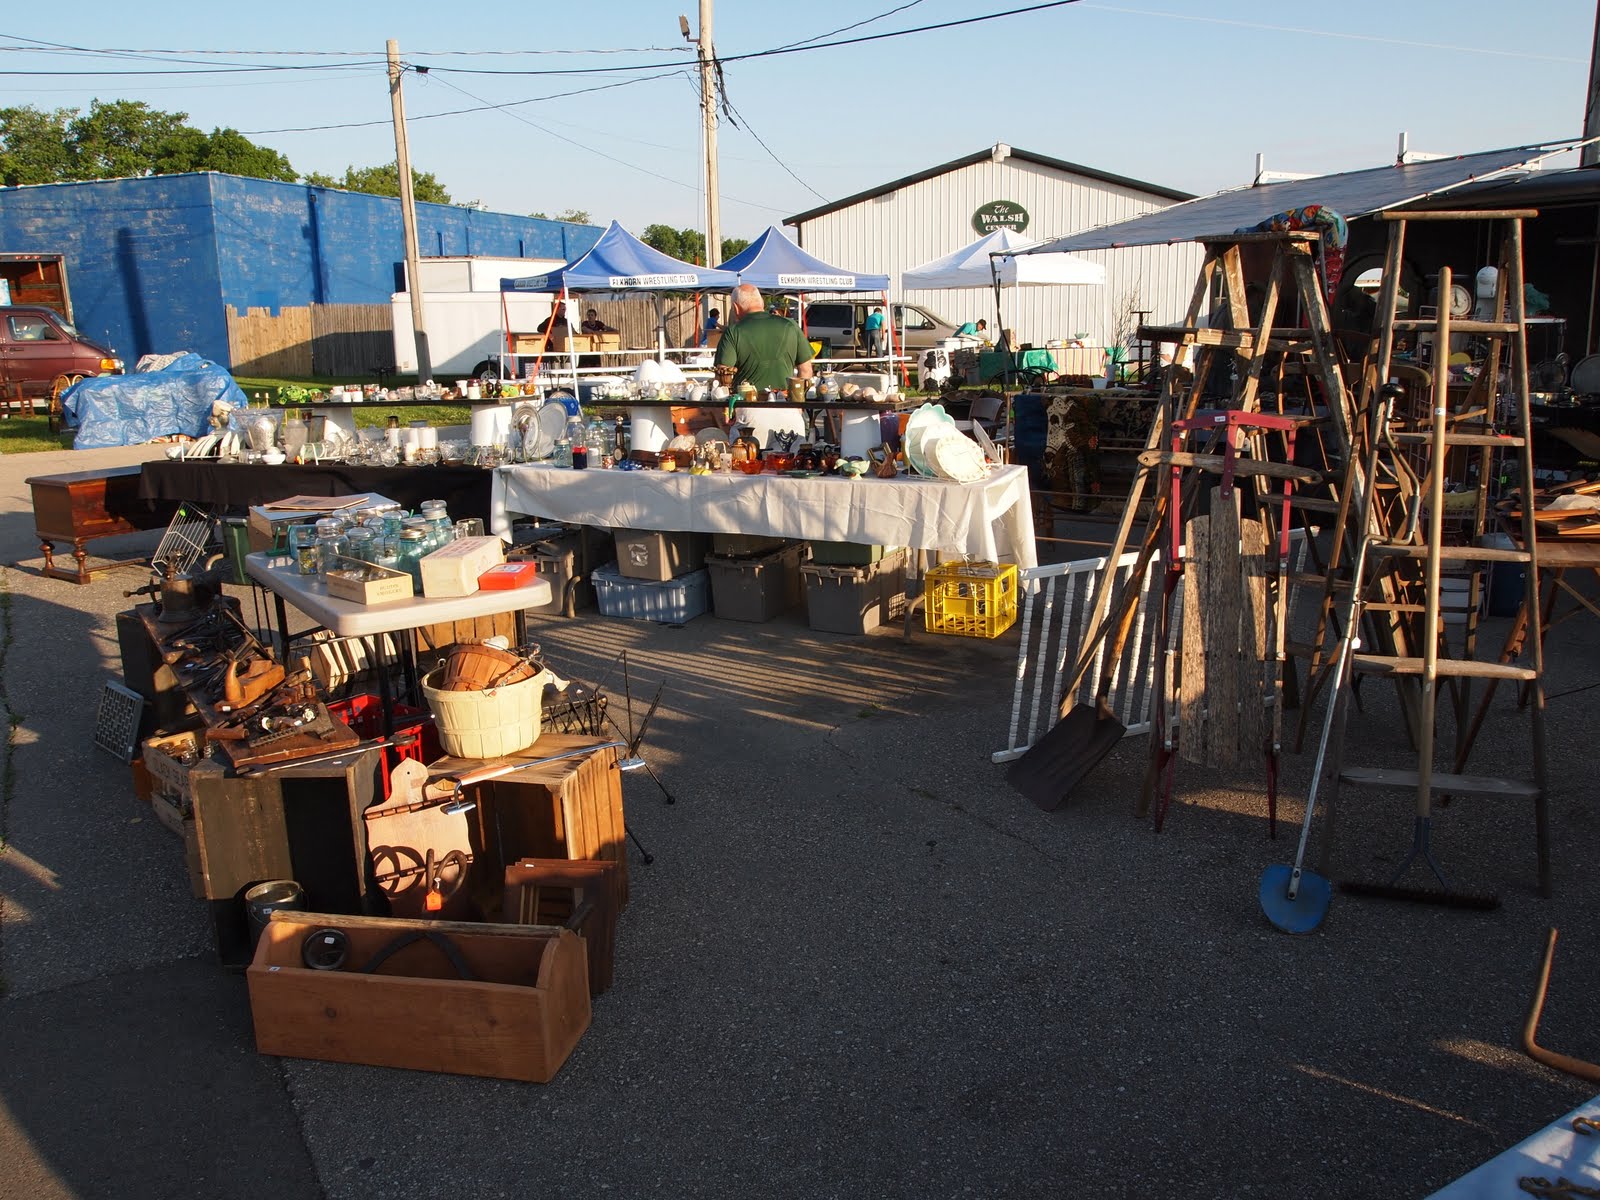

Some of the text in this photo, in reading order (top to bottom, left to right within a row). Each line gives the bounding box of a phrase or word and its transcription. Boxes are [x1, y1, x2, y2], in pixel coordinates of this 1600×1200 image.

[994, 204, 1009, 214] The
[980, 212, 1024, 224] WALSH
[643, 275, 679, 285] WRESTLING
[680, 274, 696, 283] CLUB
[780, 276, 854, 286] ELKHORN WRESTLING CLUB
